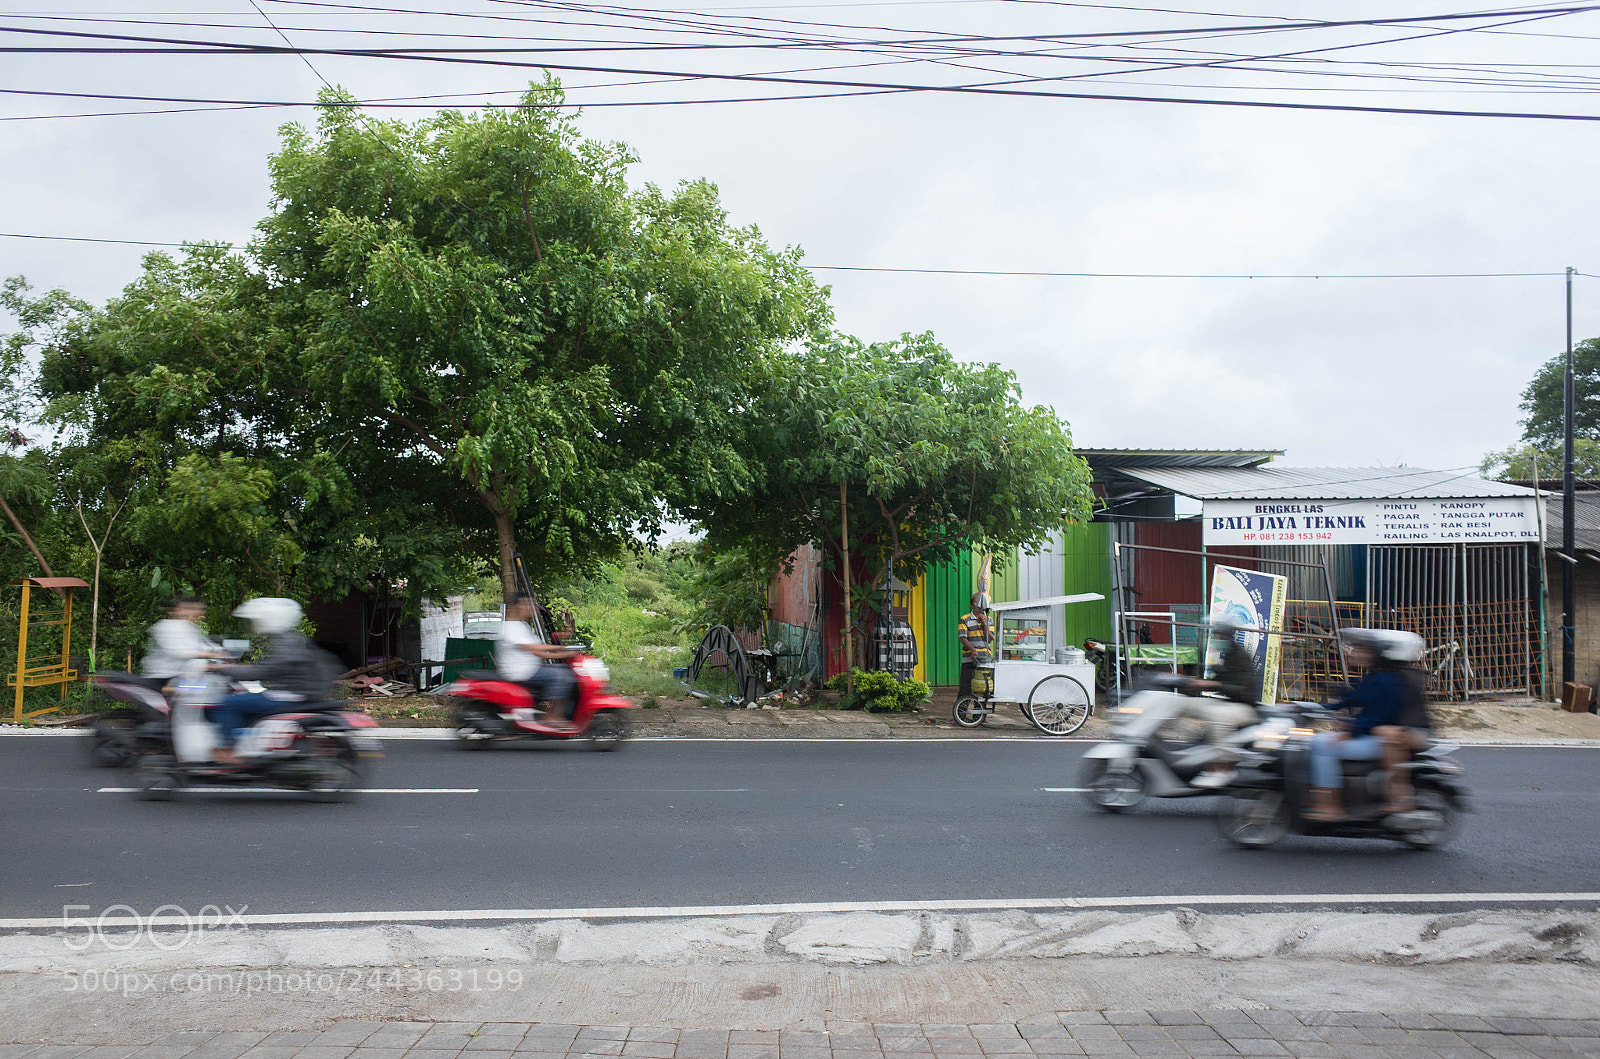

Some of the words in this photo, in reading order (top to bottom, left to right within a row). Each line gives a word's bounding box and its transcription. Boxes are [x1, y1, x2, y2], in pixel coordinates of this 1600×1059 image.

[1255, 505, 1300, 514] BENGKEL
[1304, 504, 1324, 513] LAS
[1383, 503, 1417, 511] PINTU
[1440, 502, 1486, 510] KANOPY
[1383, 513, 1420, 521] PAGAR
[1440, 512, 1485, 520] TANGGA
[1488, 511, 1525, 519] PUTAR
[1212, 516, 1252, 530] BALI
[1258, 516, 1297, 531] JAYA
[1303, 515, 1366, 529] TEKNIK
[1383, 522, 1430, 531] TERALIS
[1466, 521, 1491, 529] BESI
[1243, 533, 1257, 541] HP.
[1259, 533, 1275, 541] 081
[1316, 532, 1332, 540] 942
[1383, 532, 1429, 541] RAILING
[1440, 531, 1461, 539] LAS
[1464, 530, 1517, 539] KNALPOT,
